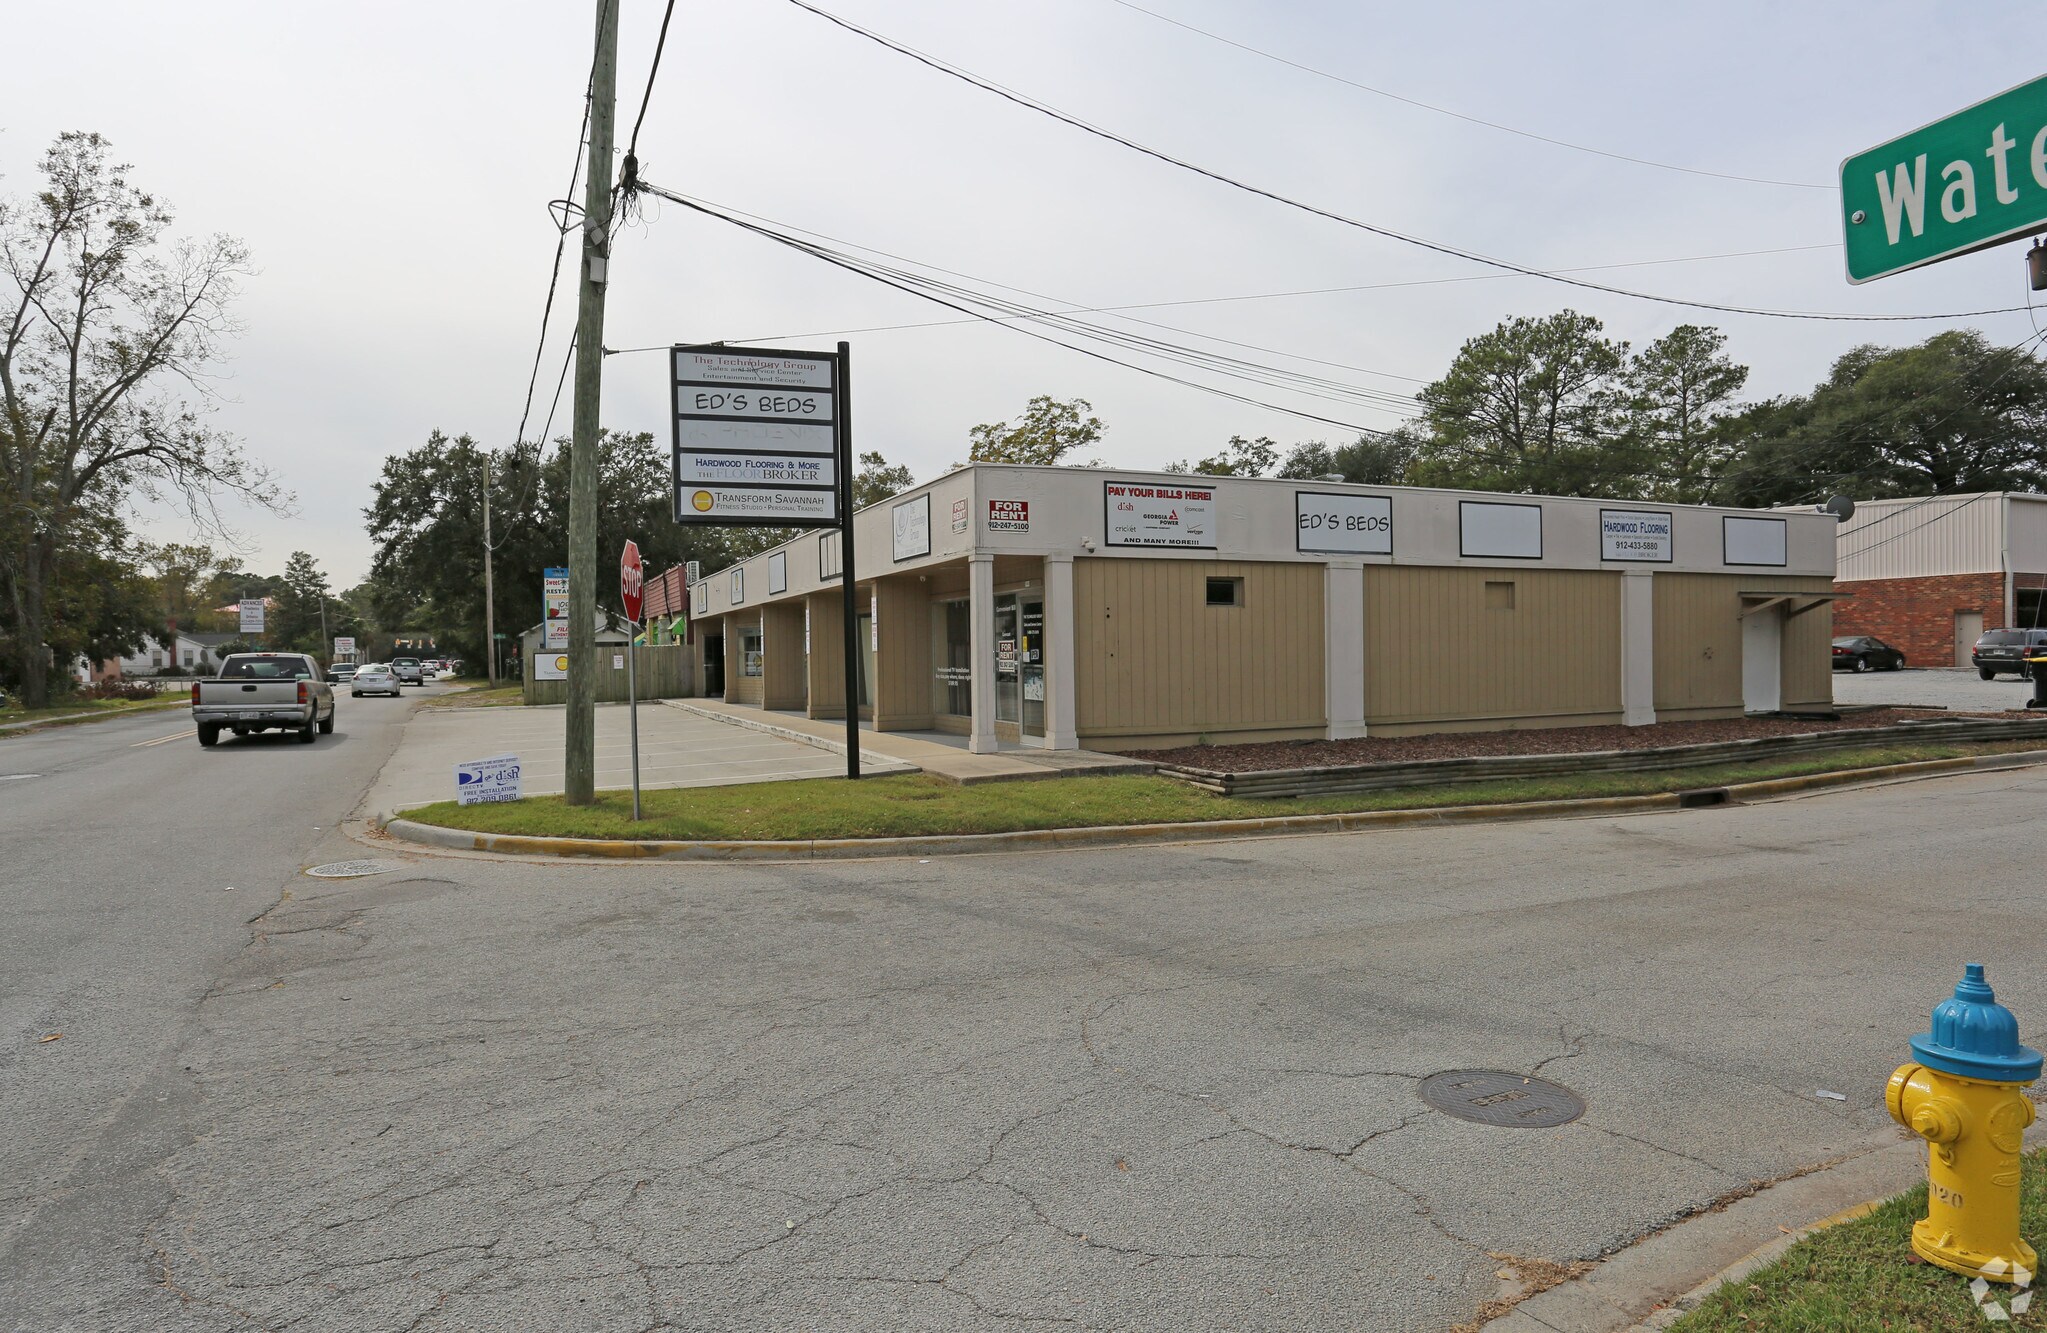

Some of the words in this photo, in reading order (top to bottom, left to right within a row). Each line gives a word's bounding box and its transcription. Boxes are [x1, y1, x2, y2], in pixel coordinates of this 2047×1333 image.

[693, 355, 713, 365] The
[718, 357, 780, 369] Technology
[783, 361, 817, 371] Group
[702, 373, 757, 382] Entertainment
[775, 376, 806, 385] Security
[695, 393, 748, 411] ED'S
[758, 396, 817, 414] BEDS
[788, 461, 795, 469] &
[1108, 486, 1126, 496] PAY
[1128, 487, 1154, 498] YOUR
[1156, 489, 1183, 500] BILLS
[954, 499, 965, 511] FOR
[995, 501, 1022, 511] FOR
[1117, 502, 1134, 512] dish
[953, 510, 966, 522] RENT
[991, 510, 1027, 520] RENT
[988, 521, 1029, 530] 912-247-5100
[1299, 513, 1340, 530] ED'S
[1346, 515, 1389, 532] BEDS
[1115, 524, 1137, 533] cricket
[623, 564, 642, 599] STOP
[1001, 643, 1012, 652] FOR
[1000, 652, 1013, 660] RENT
[496, 769, 519, 781] dish
[479, 786, 517, 794] INSTALLATION
